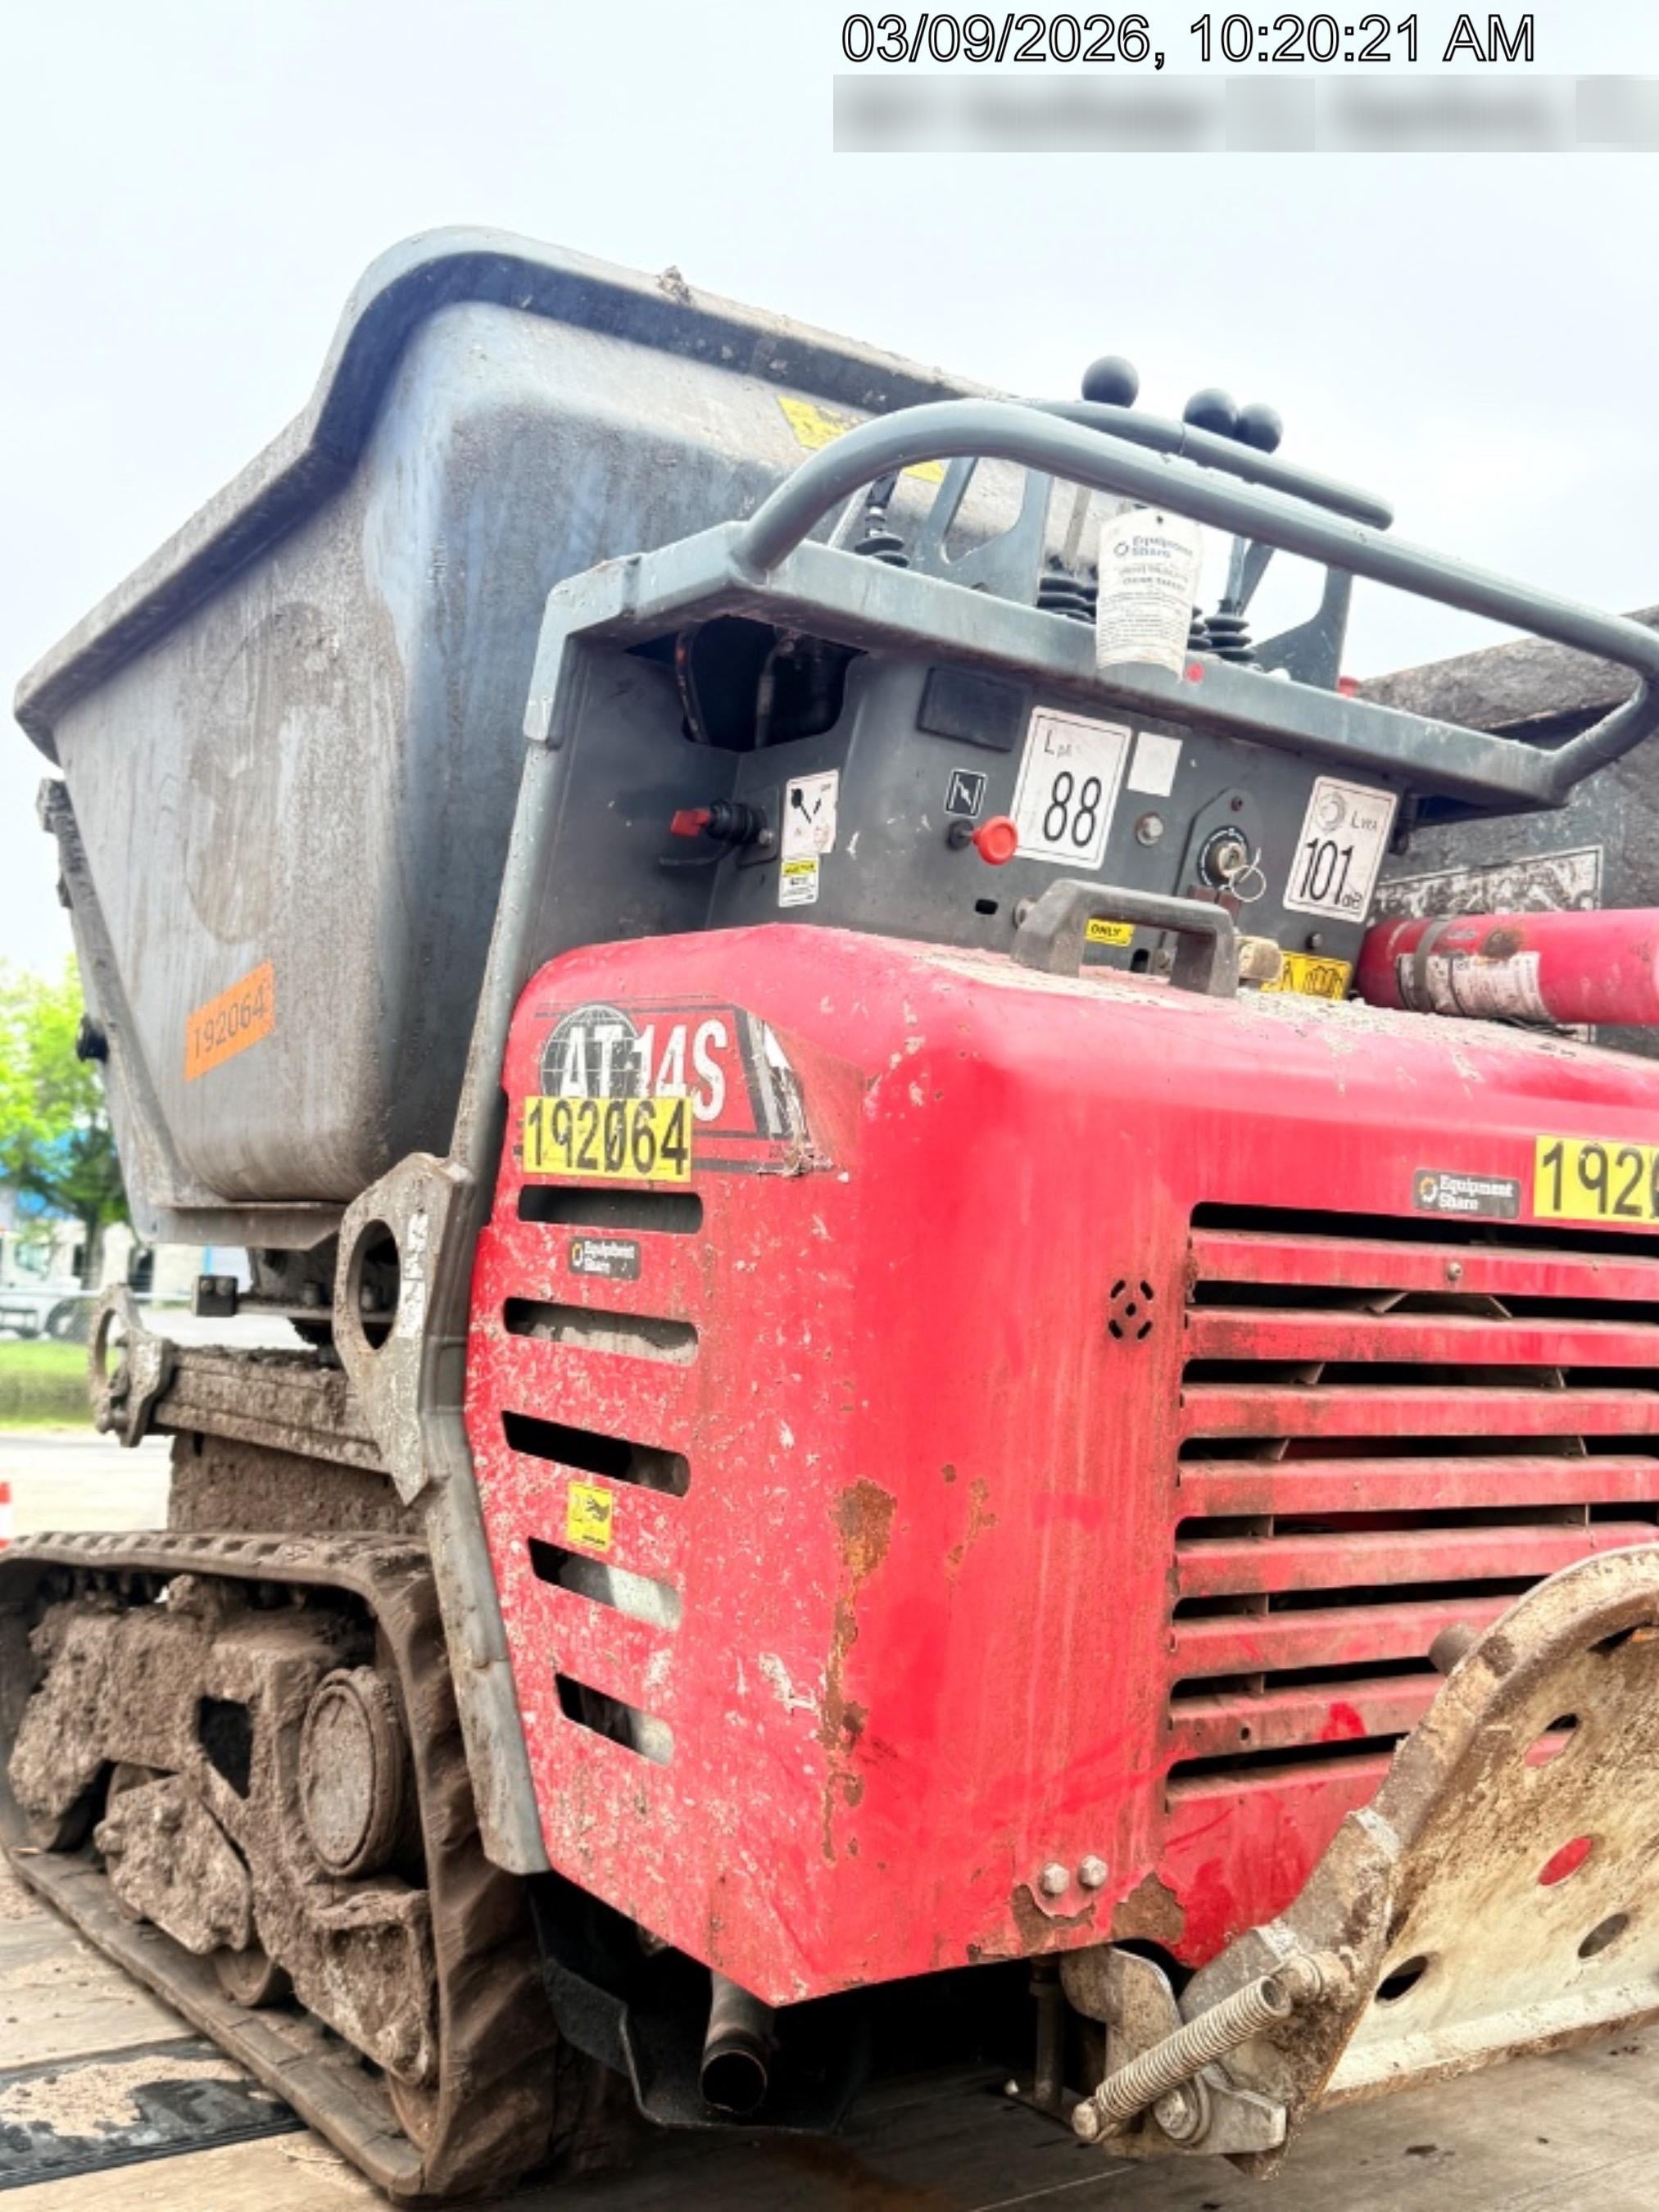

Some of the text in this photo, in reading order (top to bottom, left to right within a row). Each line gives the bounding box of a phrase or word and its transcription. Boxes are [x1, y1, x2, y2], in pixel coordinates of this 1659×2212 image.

[1042, 771, 1103, 848] 88
[1299, 836, 1355, 905] 101
[1091, 923, 1122, 937] ONLY
[193, 983, 266, 1058] 192064
[528, 1099, 690, 1176] 192064
[1439, 1174, 1513, 1199] Equipment
[1439, 1195, 1480, 1212] Share
